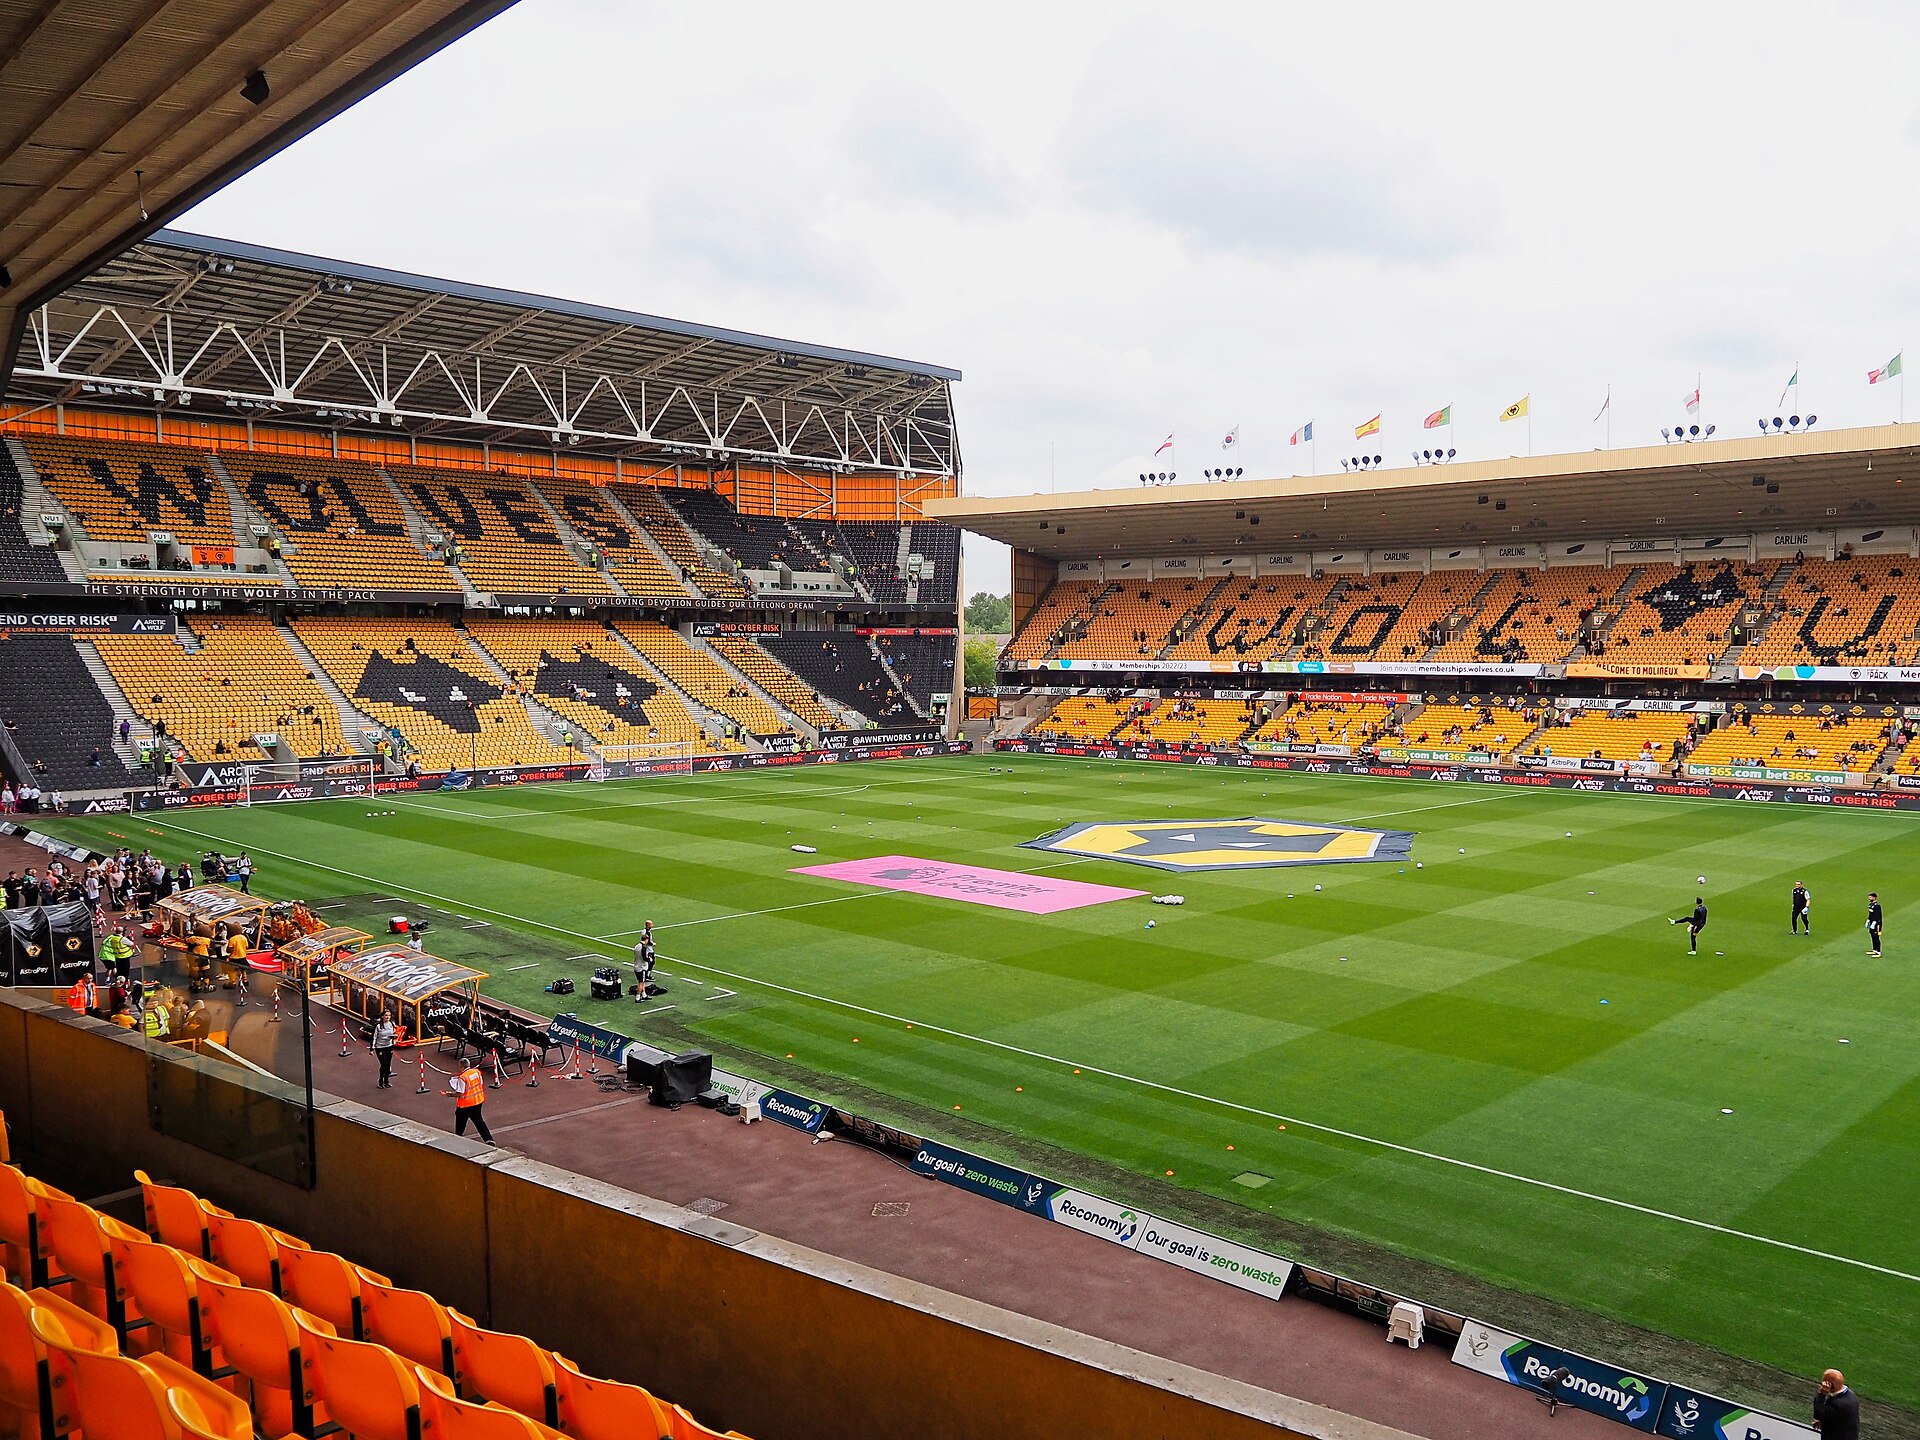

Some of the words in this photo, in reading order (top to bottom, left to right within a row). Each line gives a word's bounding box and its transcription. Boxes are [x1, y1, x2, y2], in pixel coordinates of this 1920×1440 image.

[1774, 534, 1808, 546] CARLING
[1630, 542, 1655, 550] CARLING
[1384, 552, 1410, 562] CARLING
[1500, 548, 1526, 556] CARLING
[1164, 560, 1186, 568] CARLING
[1270, 556, 1293, 565] CARLING
[1068, 562, 1088, 572] CARLING
[82, 584, 108, 594] THE
[115, 585, 186, 596] STRENGTH
[191, 586, 208, 597] OF
[214, 587, 238, 598] THE
[244, 588, 280, 598] WOLF
[285, 589, 297, 599] IS
[302, 590, 316, 600] IN
[321, 590, 344, 600] THE
[348, 590, 376, 600] PACK
[588, 597, 606, 606] OUR
[610, 598, 644, 606] LOVING
[648, 598, 690, 608] DEVOTION
[695, 600, 726, 608] GUIDES
[729, 600, 746, 608] OUR
[748, 601, 786, 609] LIFELONG
[789, 602, 814, 610] DREAM
[0, 615, 28, 625] END
[32, 615, 76, 626] CYBER
[82, 616, 110, 626] RISK
[738, 624, 761, 632] CYBER
[763, 624, 779, 632] RISK
[1120, 662, 1160, 670] Memberships
[1418, 665, 1515, 674] memberships.wolves.co.uk
[1596, 662, 1629, 675] WELCOME
[1632, 667, 1640, 675] TO
[1643, 667, 1678, 676] MOLINEUX
[1220, 691, 1244, 699] CARLING
[1580, 700, 1608, 708] CARLING
[1644, 701, 1673, 709] CARLING
[772, 738, 796, 746] ARCTIC
[852, 734, 911, 745] @AWNETWORKS
[1432, 751, 1490, 762] bet365.com
[1551, 759, 1578, 768] AstroPay
[1583, 760, 1612, 769] AstroPay
[1619, 762, 1647, 771] AroPay
[302, 767, 323, 776] END
[326, 765, 357, 774] CYBER
[360, 764, 382, 772] RISK
[547, 771, 564, 779] RISK
[1394, 769, 1411, 777] RISK
[1689, 764, 1762, 779] bet365.com
[1502, 776, 1529, 784] CYBER
[1766, 769, 1844, 784] bet365.com
[399, 781, 419, 789] RISK
[1656, 785, 1686, 794] CYBER
[1689, 787, 1710, 796] RISK
[164, 796, 188, 804] END
[190, 792, 224, 803] CYBER
[227, 791, 249, 800] RISK
[1833, 796, 1868, 805] CYBER
[1871, 798, 1896, 807] RISK
[920, 879, 1028, 898] League
[950, 874, 1056, 894] Premier
[60, 960, 90, 969] AstroPay
[20, 966, 48, 975] AstroPay
[352, 950, 452, 996] AstroPay
[428, 1005, 467, 1017] AstroPay
[550, 1022, 560, 1033] Our
[560, 1026, 572, 1037] goal
[577, 1032, 588, 1044] zero
[719, 1083, 740, 1096] waste
[767, 1098, 813, 1123] Reconomy
[917, 1150, 936, 1164] Our
[935, 1157, 957, 1174] goal
[957, 1164, 965, 1176] is
[966, 1168, 988, 1184] zero
[988, 1176, 1018, 1194] waste
[1060, 1200, 1126, 1234] Reconomy
[1146, 1230, 1169, 1248] Our
[1168, 1238, 1197, 1258] goal
[1198, 1246, 1210, 1262] is
[1210, 1254, 1238, 1272] zero
[1241, 1264, 1282, 1286] waste
